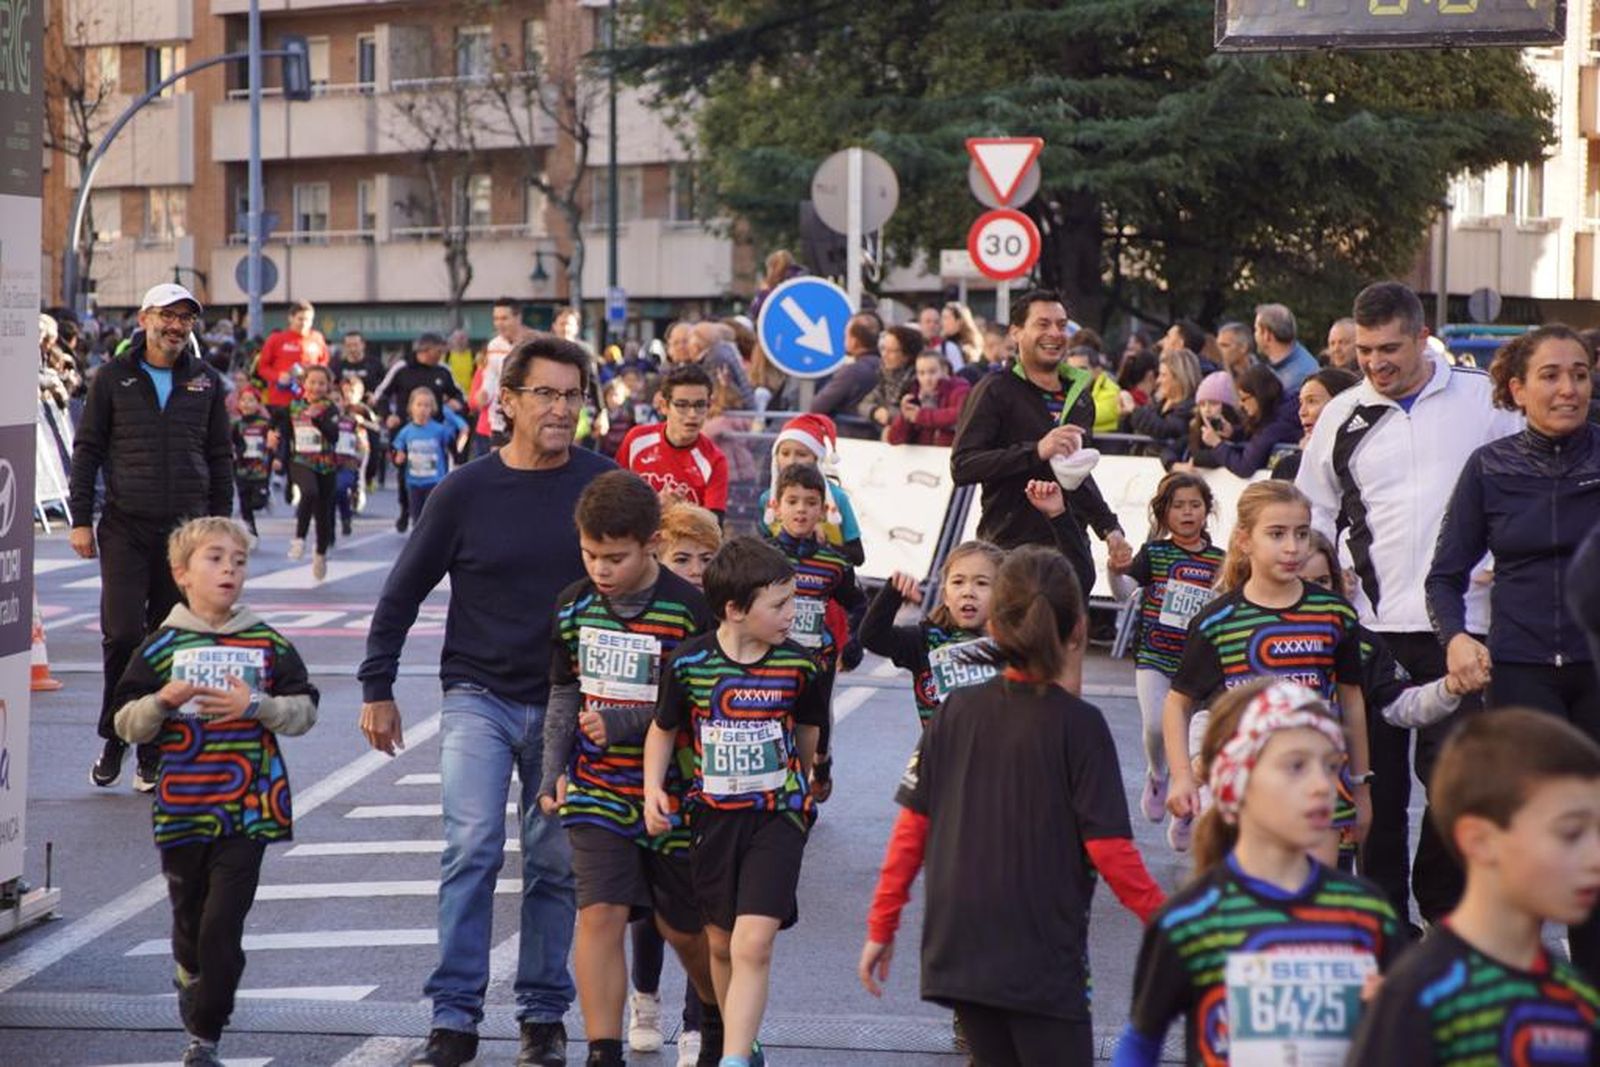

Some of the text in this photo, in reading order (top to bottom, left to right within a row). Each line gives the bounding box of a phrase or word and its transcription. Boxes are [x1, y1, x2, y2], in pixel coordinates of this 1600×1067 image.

[985, 235, 1022, 256] 30
[1171, 593, 1207, 616] 605
[793, 611, 814, 632] 39
[598, 634, 652, 651] SETEL
[586, 646, 638, 678] 6306
[722, 727, 774, 743] SETEL
[715, 744, 765, 773] 6153
[1271, 961, 1360, 980] SETEL
[1251, 985, 1346, 1032] 6425
